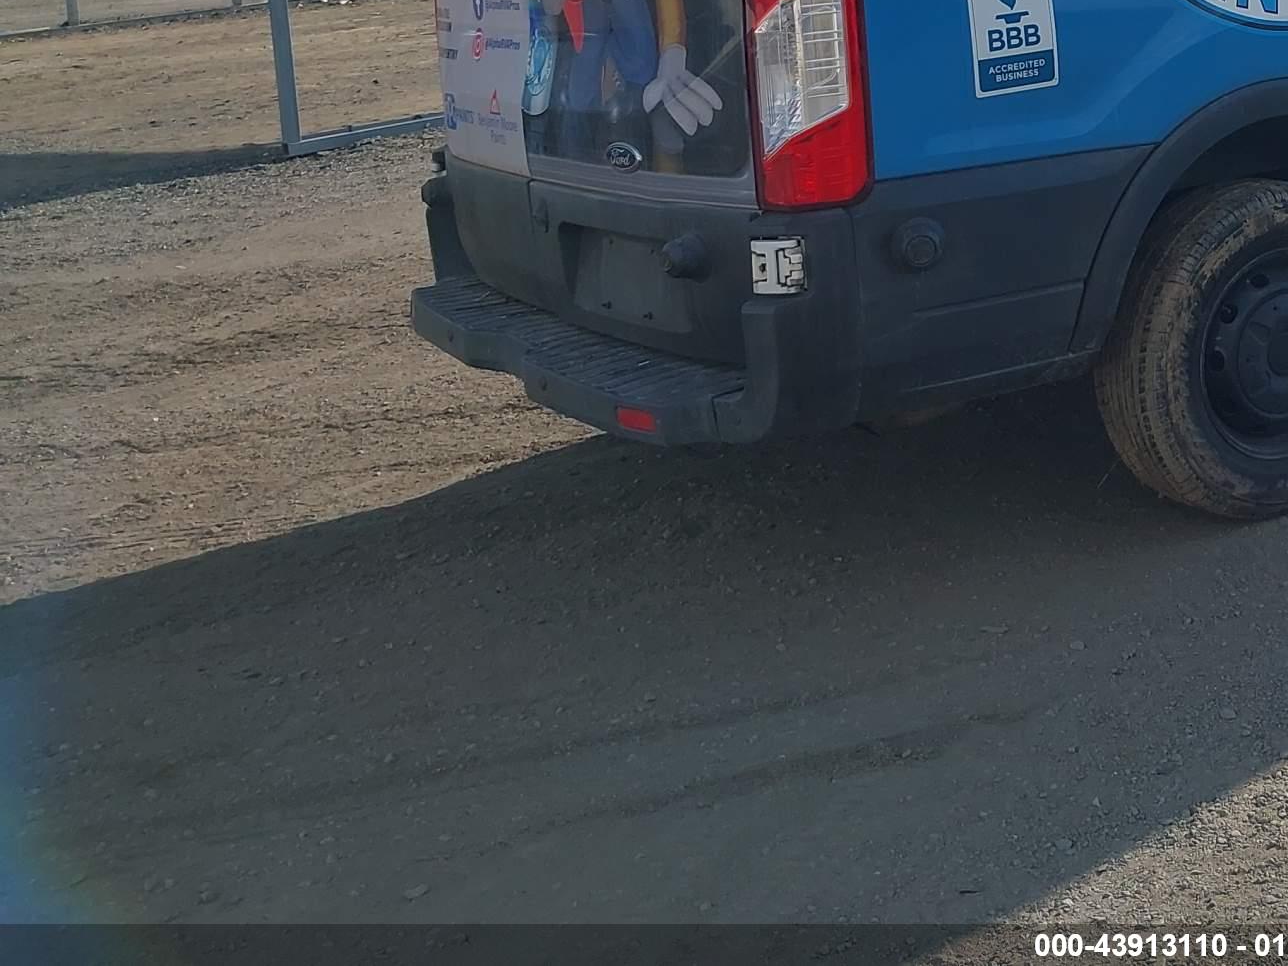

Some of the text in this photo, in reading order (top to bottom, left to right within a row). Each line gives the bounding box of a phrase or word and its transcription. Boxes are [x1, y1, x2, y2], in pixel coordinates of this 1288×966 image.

[988, 24, 1041, 52] BBB
[989, 58, 1046, 75] ACCREDITED
[996, 69, 1039, 83] BUSINESS
